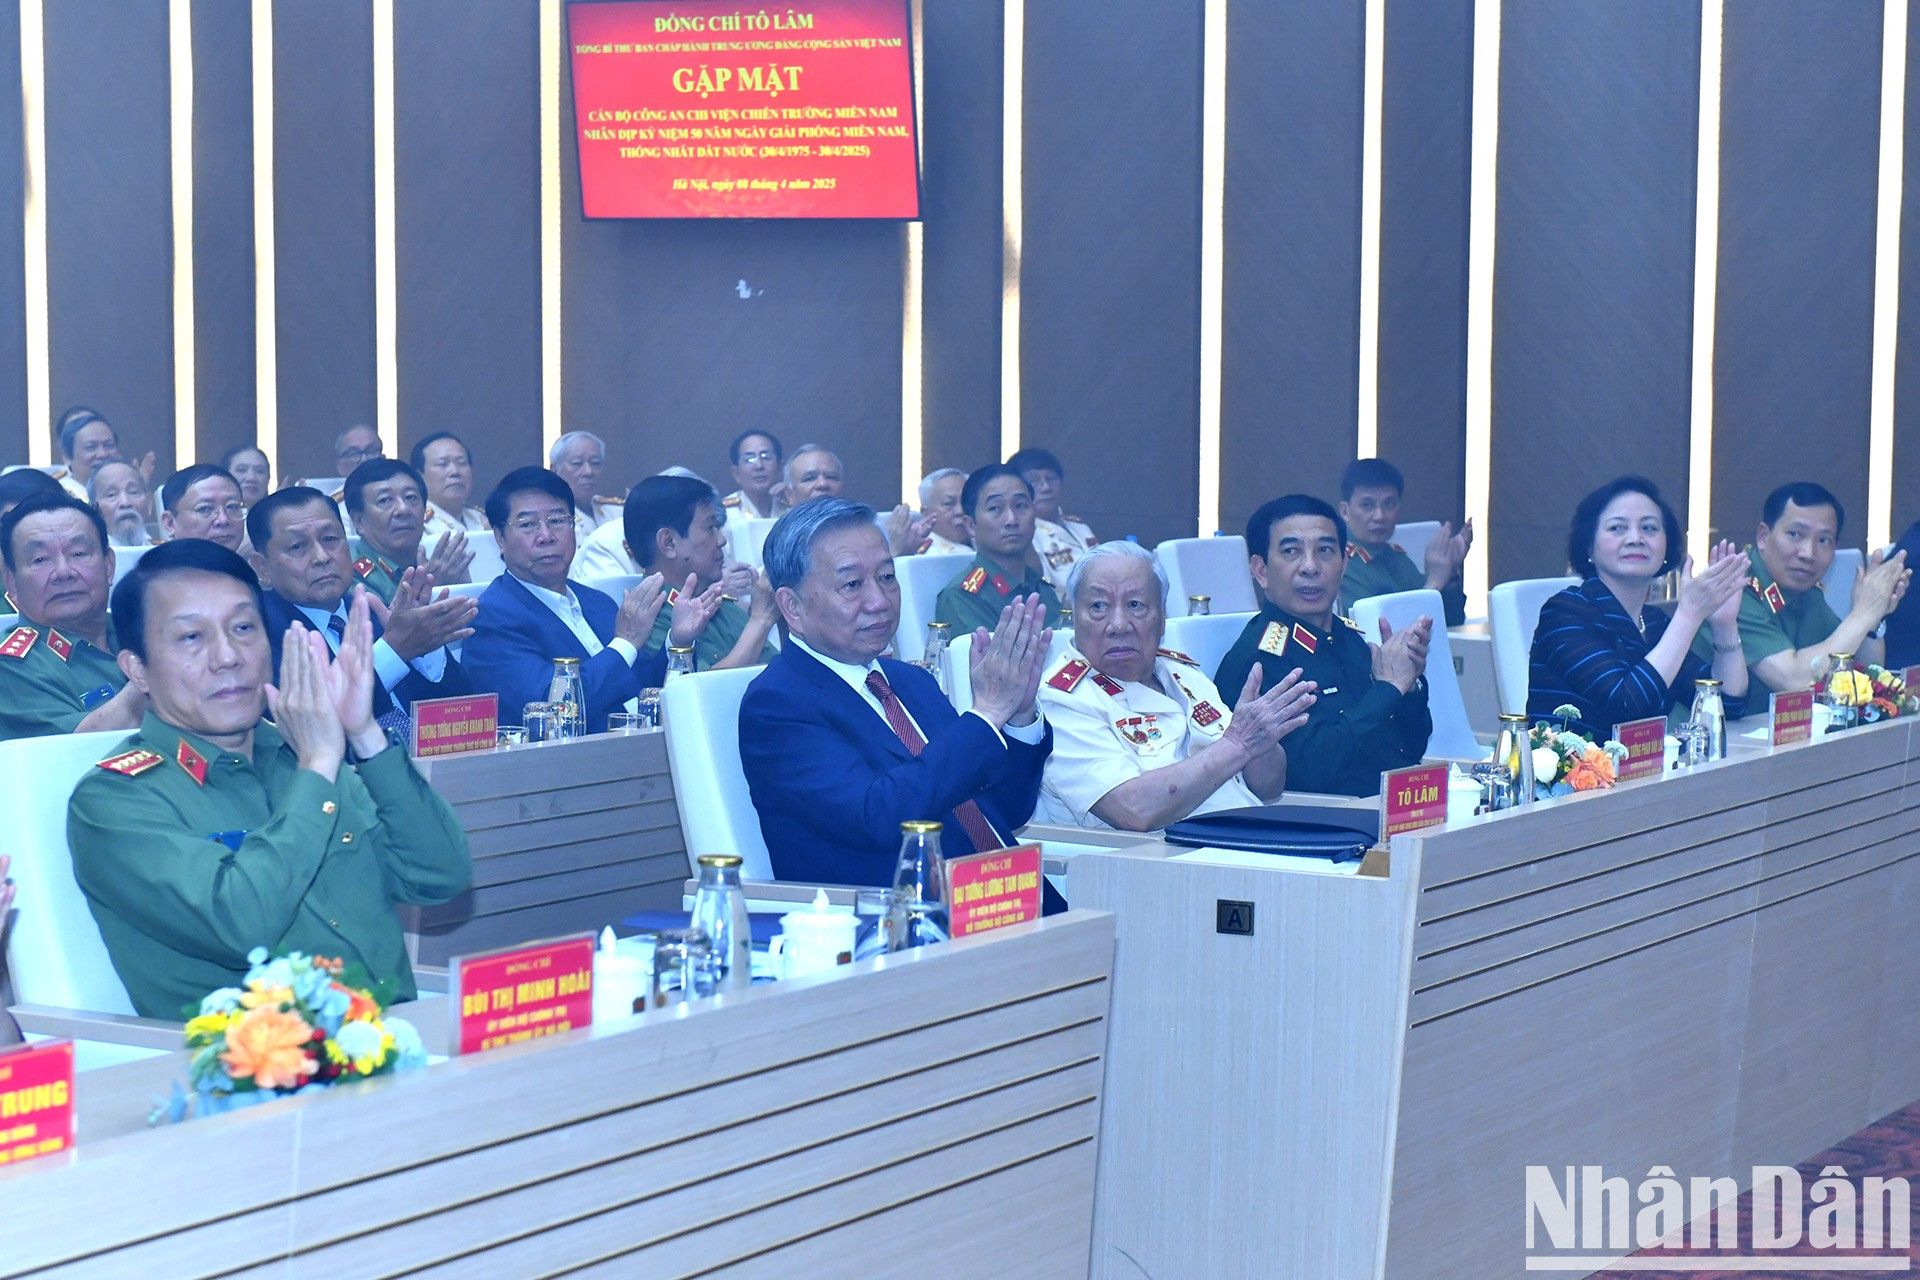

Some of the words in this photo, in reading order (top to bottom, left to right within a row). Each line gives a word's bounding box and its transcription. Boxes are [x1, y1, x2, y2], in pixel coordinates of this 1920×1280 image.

[655, 13, 704, 33] ĐỒNG
[709, 12, 740, 31] CHÍ
[744, 10, 770, 30] TÔ
[774, 9, 813, 30] LÂM
[878, 38, 901, 47] NAM
[673, 64, 732, 98] GẶP
[737, 63, 803, 97] MẶT
[633, 108, 666, 121] CÔNG
[669, 110, 684, 121] AN
[686, 110, 708, 121] CHI
[710, 108, 739, 122] VIỆN
[869, 107, 897, 118] NAM
[618, 129, 637, 142] DỊP
[658, 128, 688, 141] NIỆM
[691, 129, 703, 139] 50
[705, 126, 732, 139] NĂM
[734, 126, 767, 138] NGÀY
[798, 124, 840, 137] PHÓNG
[723, 144, 757, 157] NƯỚC
[673, 178, 688, 190] Hà
[780, 179, 786, 189] 4
[812, 178, 836, 189] 2025
[1398, 787, 1411, 806] TÔ
[1414, 785, 1438, 804] LÂM
[1228, 908, 1242, 928] A
[463, 989, 489, 1017] BÙI
[492, 986, 514, 1012] THỊ
[517, 978, 555, 1004] MINH
[0, 1080, 68, 1118] RUNG
